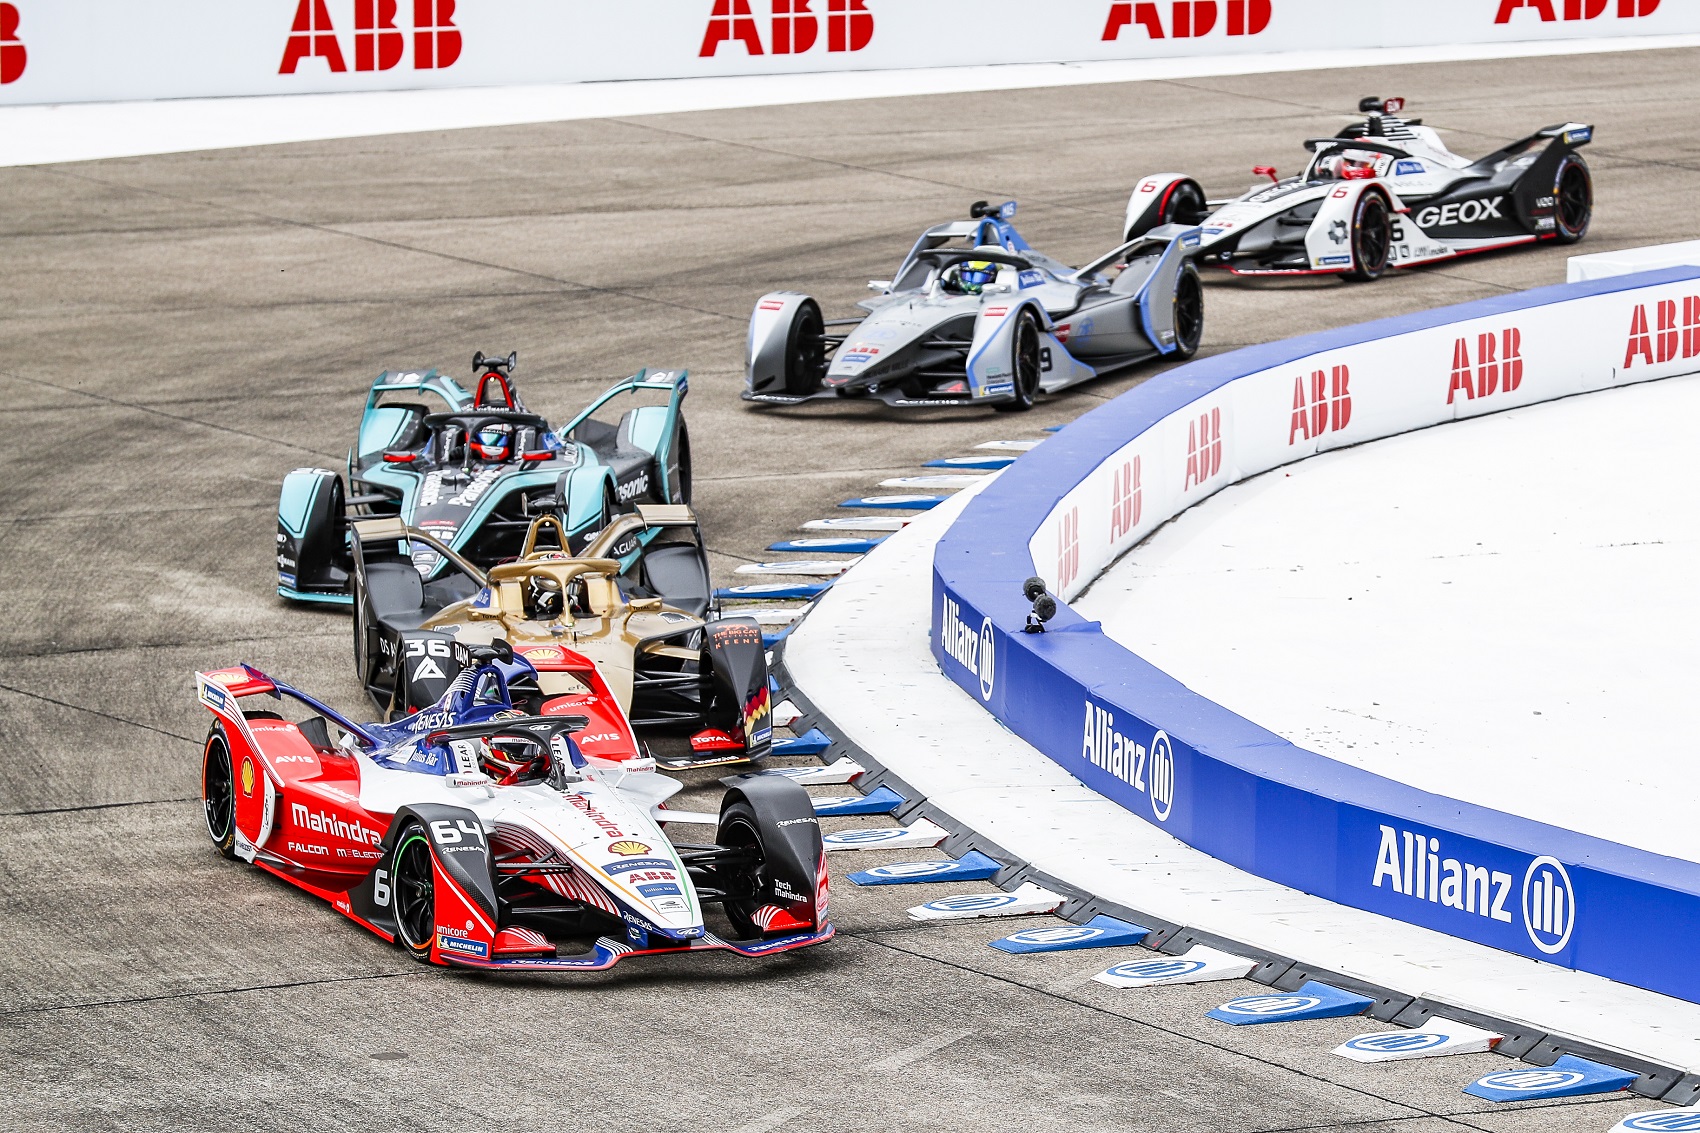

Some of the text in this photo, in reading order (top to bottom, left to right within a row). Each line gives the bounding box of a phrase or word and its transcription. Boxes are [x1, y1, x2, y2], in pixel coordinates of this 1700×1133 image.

[278, 0, 462, 74] ABB
[698, 0, 874, 57] ABB
[1140, 181, 1157, 193] 6
[1332, 186, 1349, 198] 6
[1415, 196, 1504, 229] GEOX
[1623, 295, 1700, 369] ABB
[1447, 327, 1523, 404] ABB
[1289, 365, 1352, 445] ABB
[1184, 406, 1222, 492] ABB
[1110, 455, 1142, 544] ABB
[715, 638, 759, 650] KEENE
[942, 593, 979, 676] Allianz
[405, 639, 451, 658] 36
[454, 643, 470, 667] DAM
[549, 698, 593, 712] umicore
[411, 712, 456, 734] RENESAS
[581, 733, 620, 745] AVIS
[1082, 700, 1146, 793] Allianz
[276, 755, 315, 763] AVIS
[425, 753, 439, 767] Bär
[457, 744, 471, 768] LEAR
[292, 803, 382, 845] Mahindra
[562, 794, 624, 837] Mahindra
[430, 819, 486, 848] 64
[288, 842, 329, 856] FALCON
[611, 861, 668, 871] RENESAS
[629, 871, 676, 884] ABB
[1372, 824, 1512, 924] Allianz
[374, 869, 391, 907] 6
[774, 878, 792, 891] Tech
[774, 887, 808, 903] Mahindra
[436, 924, 469, 938] umicore
[622, 910, 653, 931] RENESAS
[450, 941, 484, 952] MICHELIN
